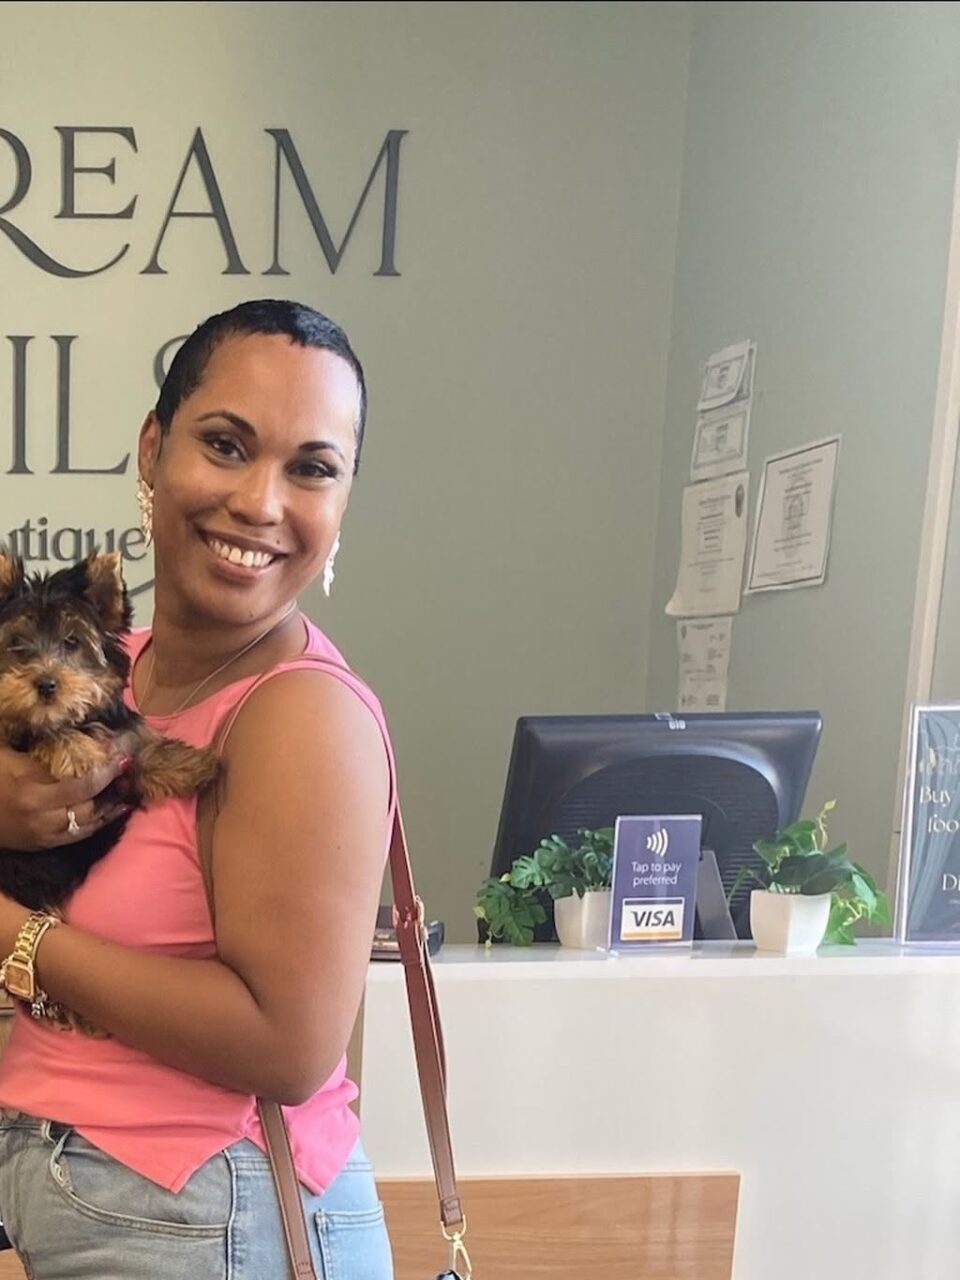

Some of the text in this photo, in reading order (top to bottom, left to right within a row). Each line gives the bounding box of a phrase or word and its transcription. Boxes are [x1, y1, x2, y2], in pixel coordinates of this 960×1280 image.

[919, 785, 952, 808] Buy
[631, 861, 682, 874] Tap to pay
[632, 875, 678, 888] preferred
[631, 910, 675, 927] VISA
